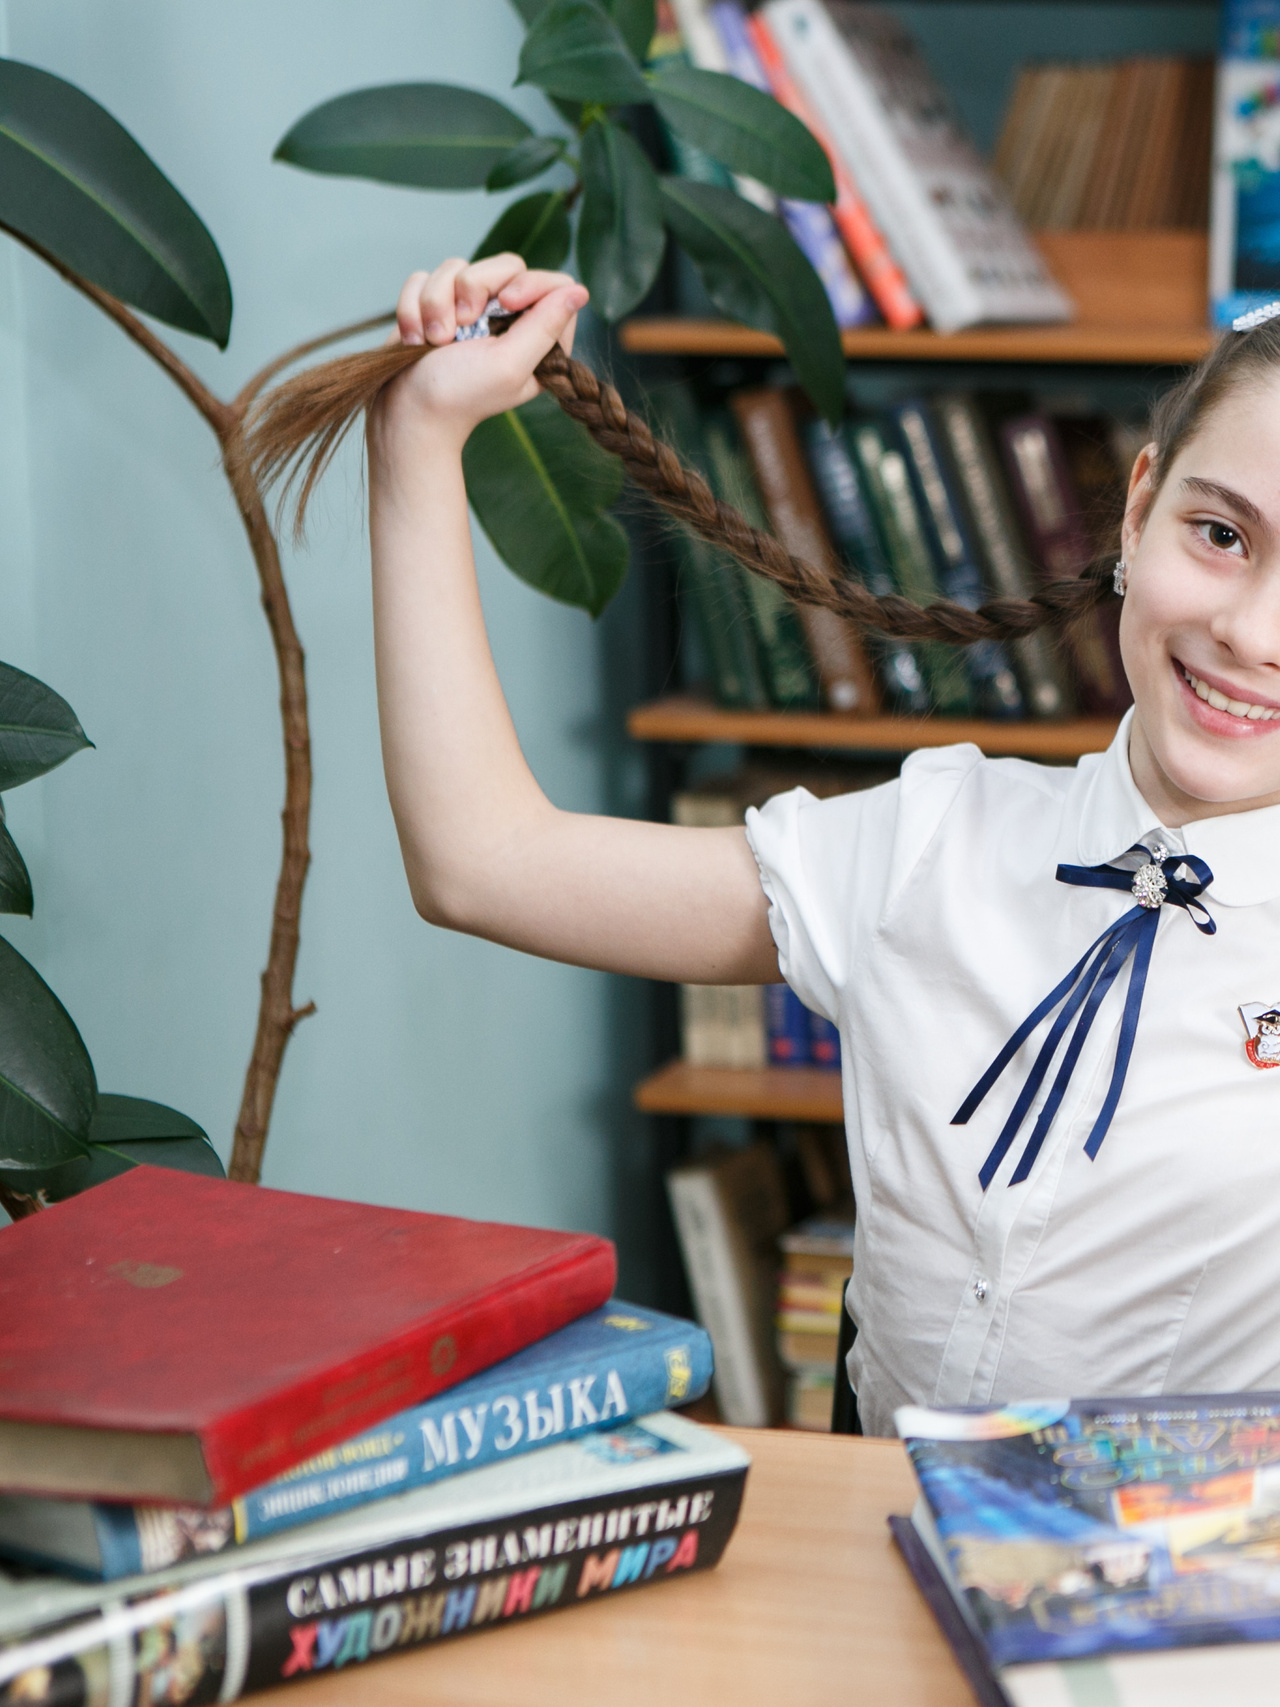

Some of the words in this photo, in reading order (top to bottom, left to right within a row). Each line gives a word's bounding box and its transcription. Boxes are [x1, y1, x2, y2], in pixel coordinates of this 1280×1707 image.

[419, 1368, 629, 1472] МУЗЫКА
[281, 1561, 571, 1679] ХУДОЖНИКИ
[576, 1528, 700, 1599] МИРА
[286, 1546, 437, 1619] САМЫЕ
[443, 1489, 715, 1581] ЗНАМЕНИТЫЕ
